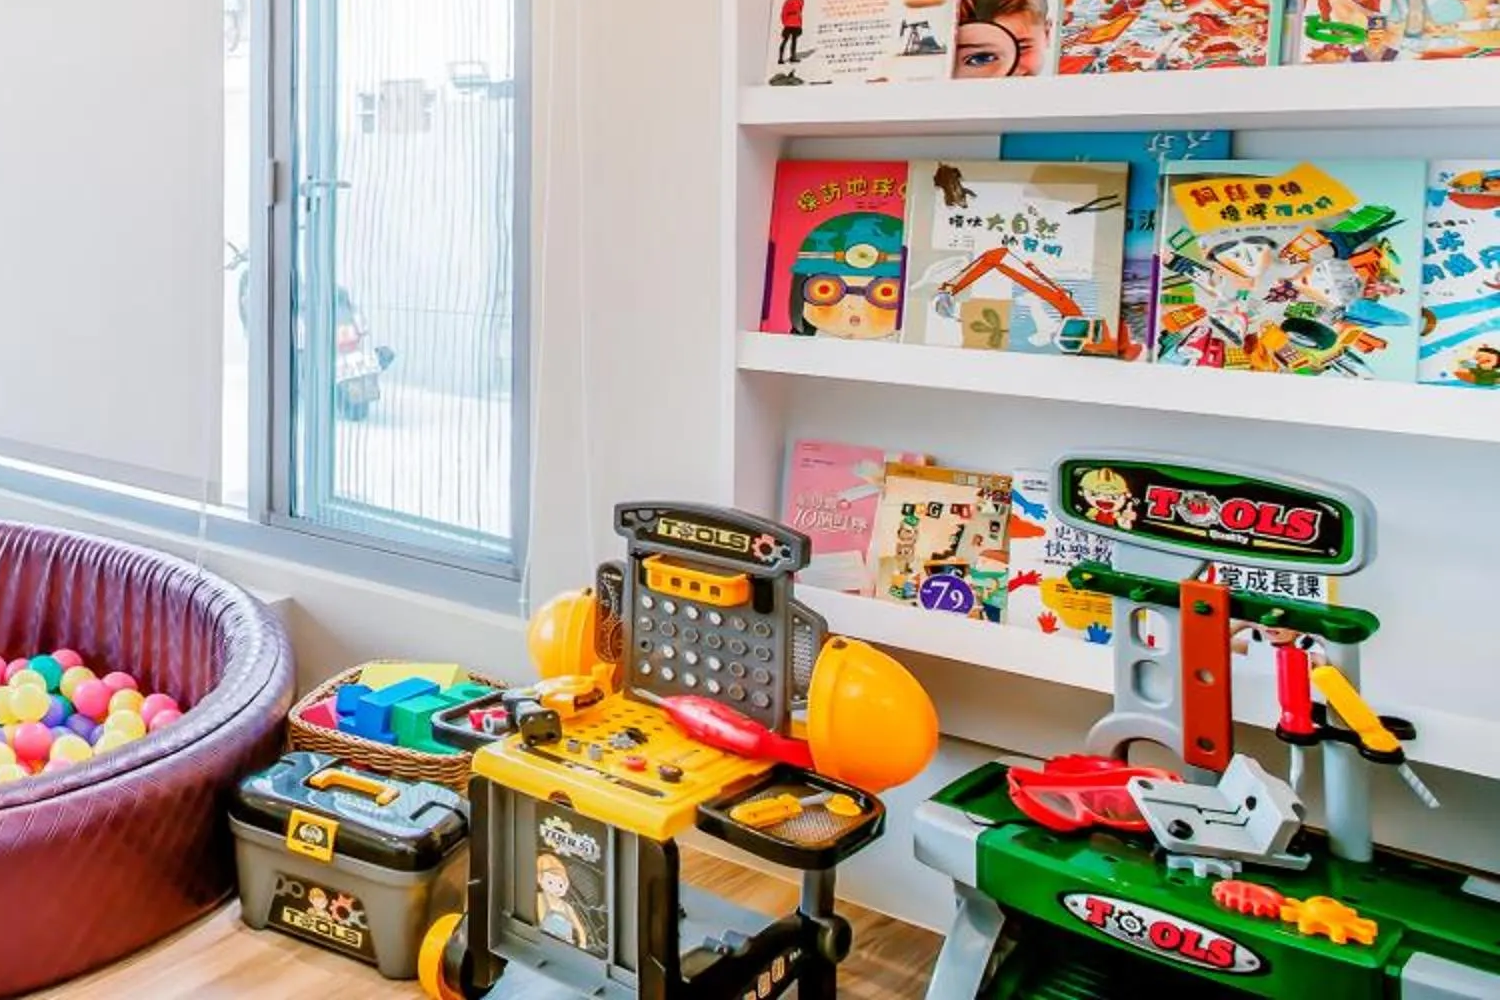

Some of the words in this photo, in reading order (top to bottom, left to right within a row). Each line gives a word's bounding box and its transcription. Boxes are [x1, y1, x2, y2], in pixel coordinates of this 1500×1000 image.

[659, 518, 749, 551] TOOLS
[1146, 486, 1322, 543] TOOLS
[283, 906, 362, 947] TOOLS
[1085, 897, 1236, 968] TOOLS
